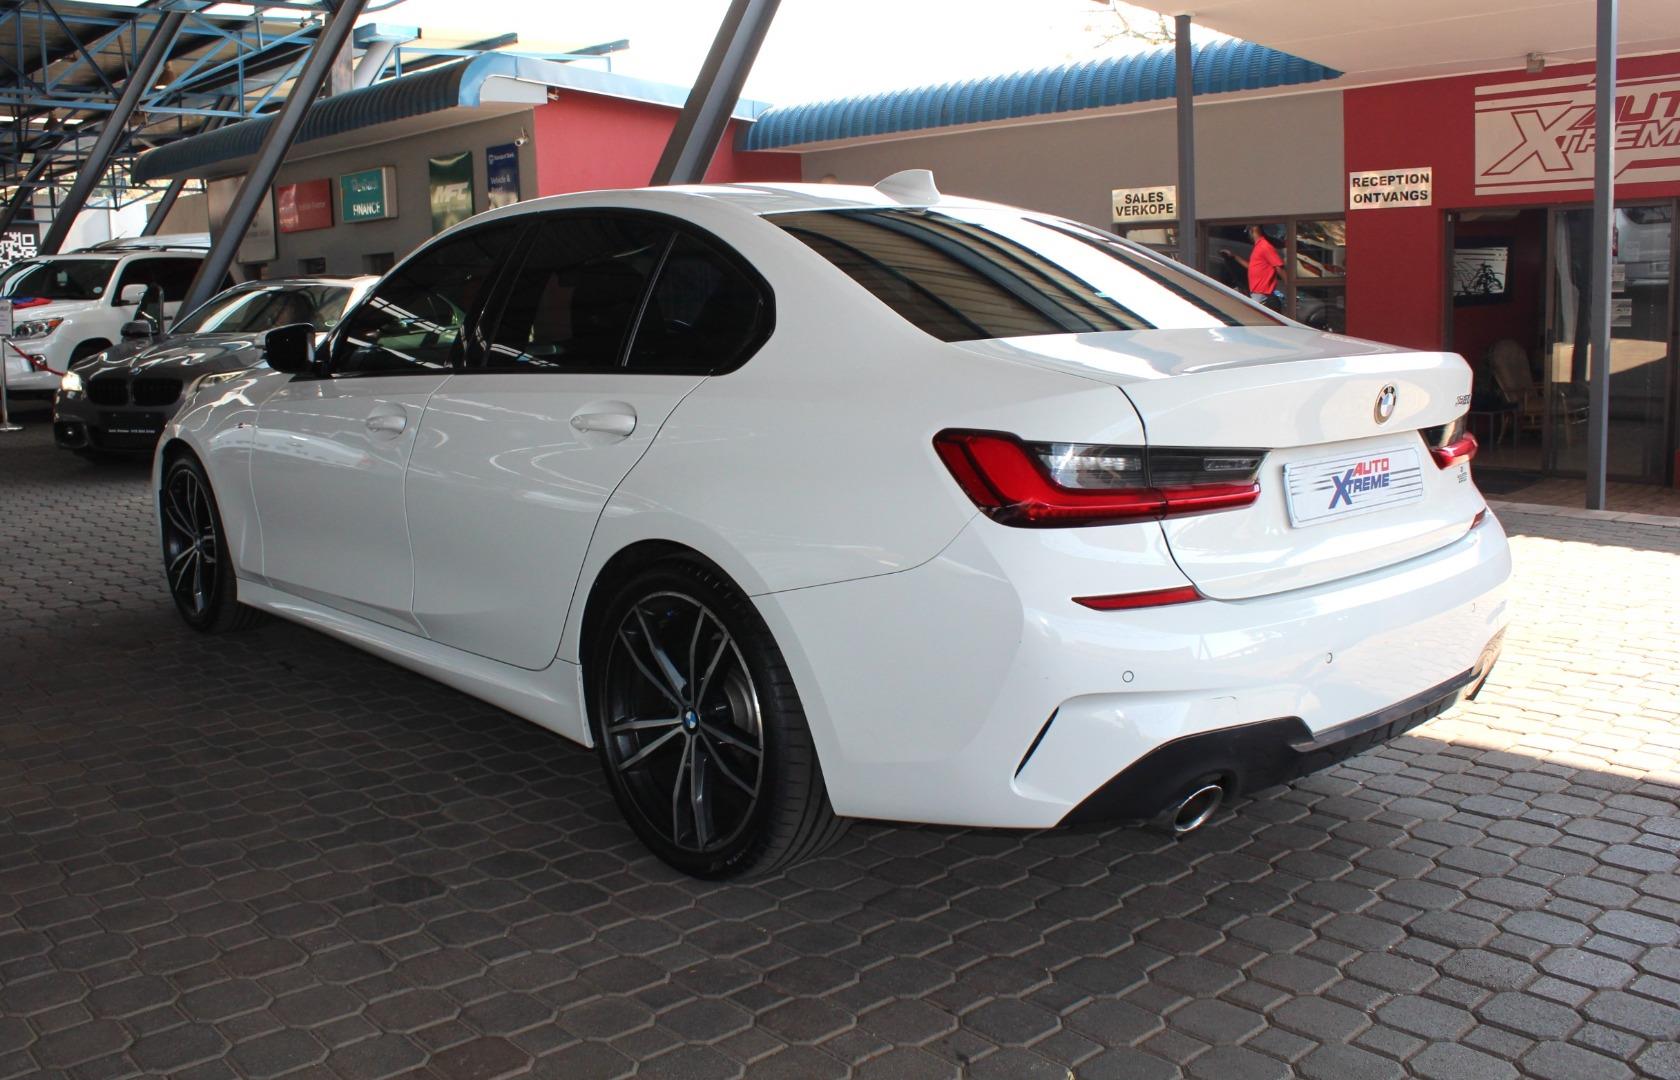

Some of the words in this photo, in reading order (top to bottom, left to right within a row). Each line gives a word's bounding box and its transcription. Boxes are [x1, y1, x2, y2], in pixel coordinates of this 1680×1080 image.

[1352, 173, 1430, 188] RECEPTION
[1125, 191, 1164, 205] SALES
[1353, 190, 1428, 204] ONTVANGS
[1115, 203, 1174, 217] VERKOPE
[1352, 457, 1390, 477] AUTO
[1328, 468, 1390, 509] XTREME
